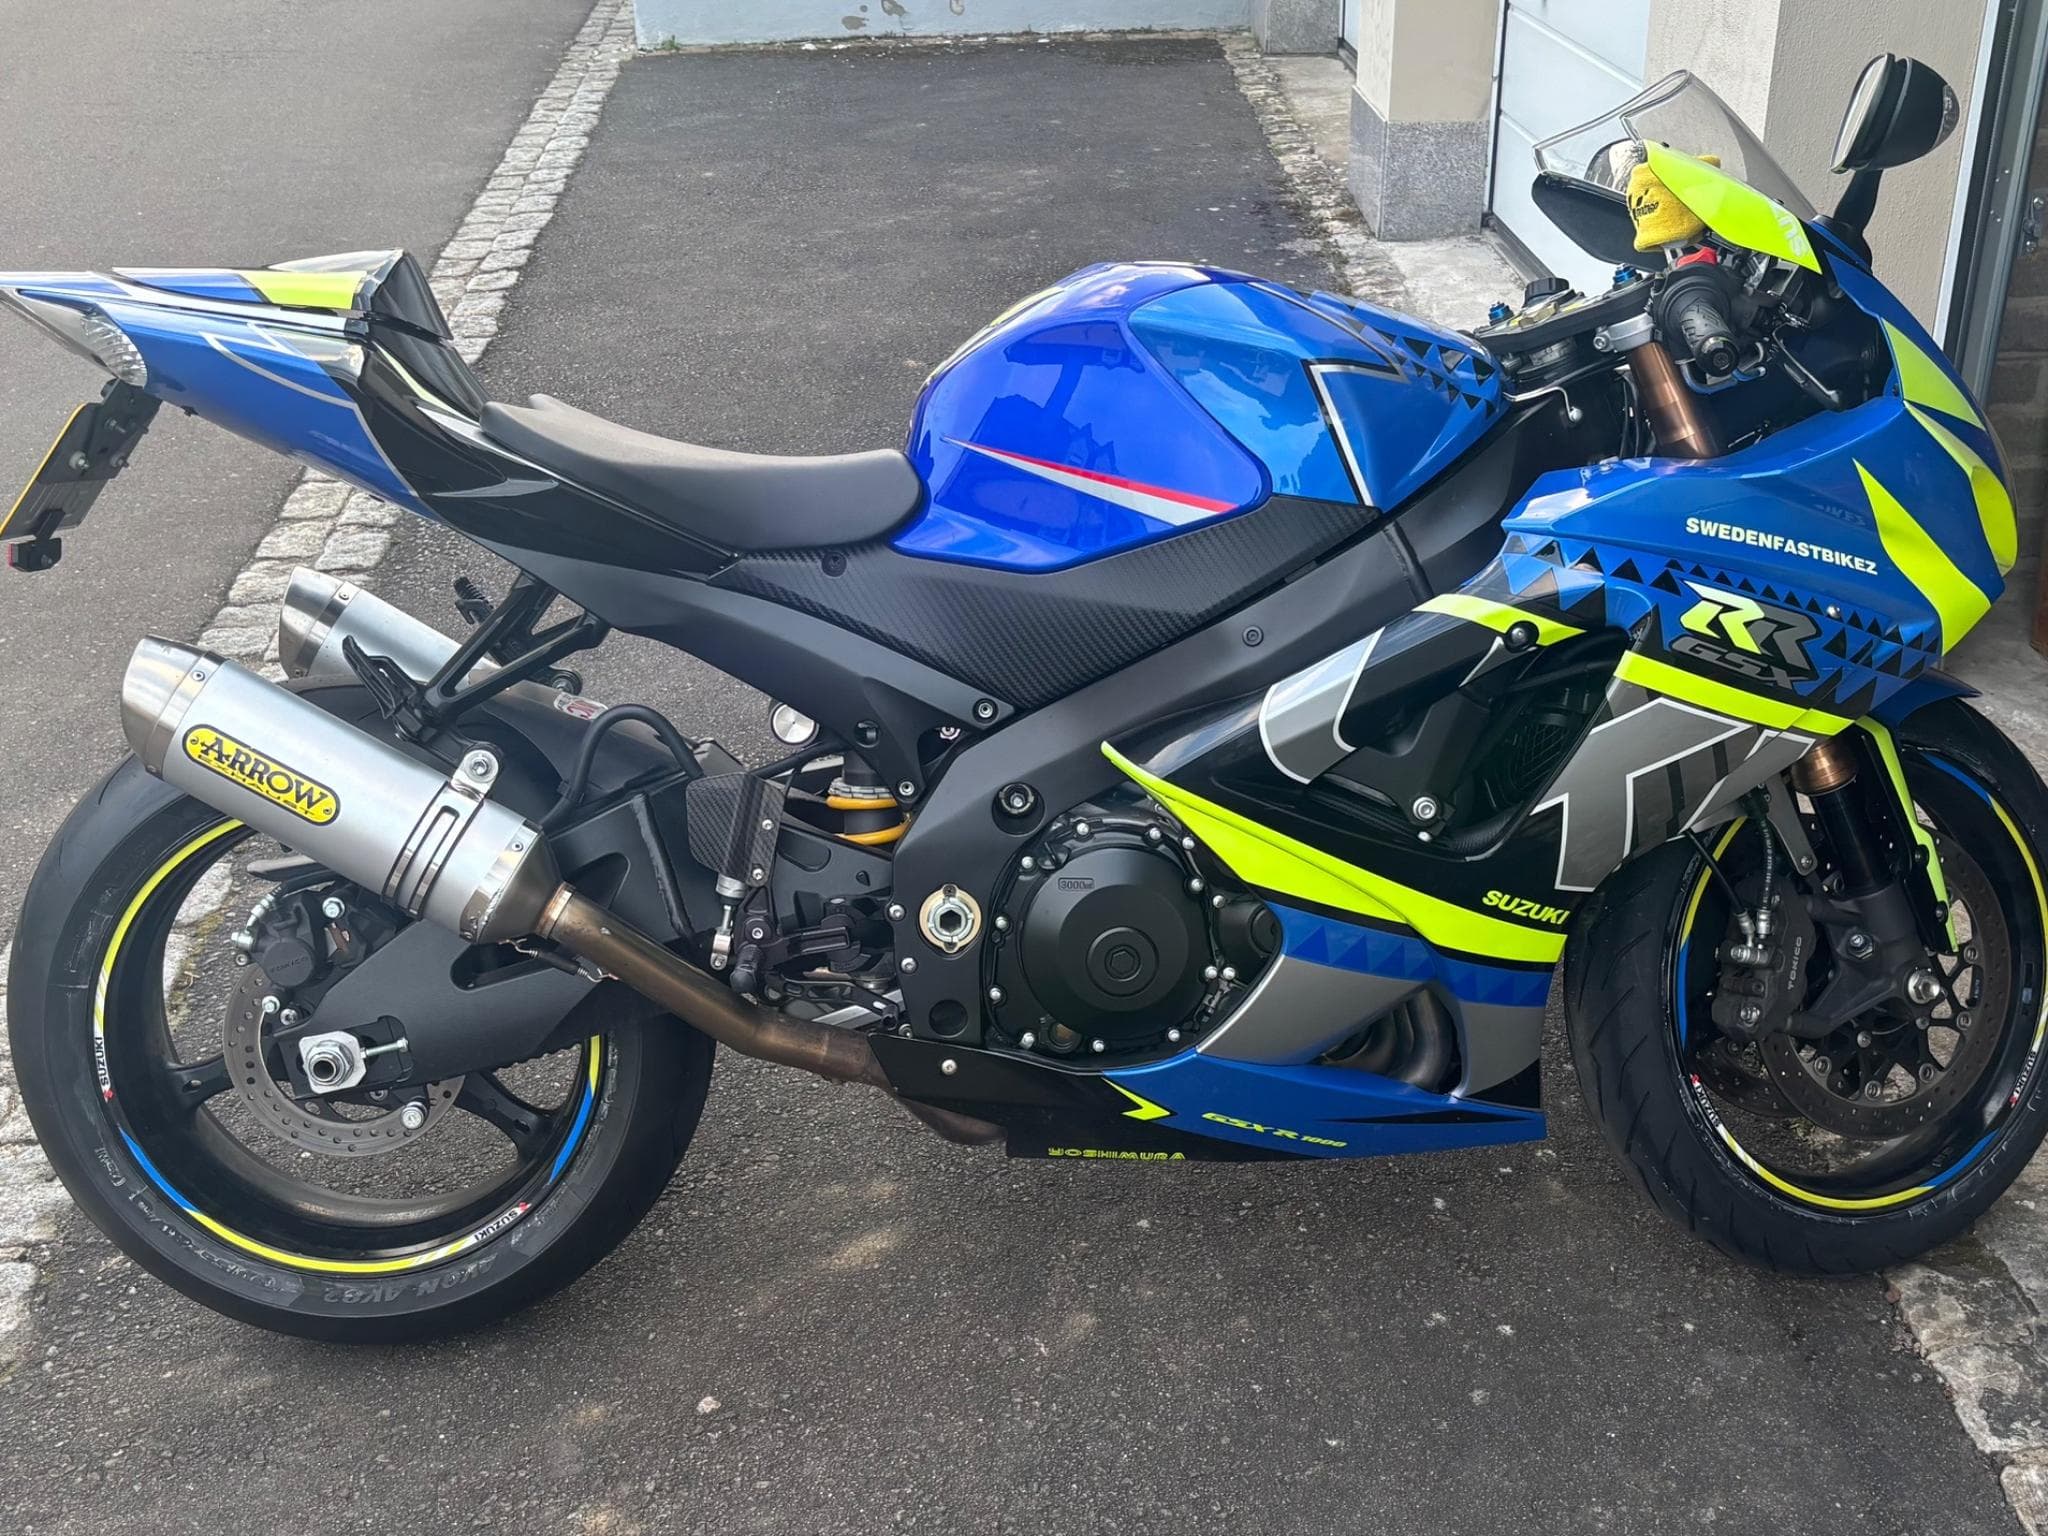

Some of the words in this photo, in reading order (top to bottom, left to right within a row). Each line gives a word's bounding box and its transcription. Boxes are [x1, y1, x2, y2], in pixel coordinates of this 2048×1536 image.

[1686, 517, 1878, 576] SWEDENFASTBIKEZ
[1671, 636, 1809, 691] GSX
[199, 736, 329, 810] ARROW
[1482, 890, 1570, 925] SUZUKI
[1787, 936, 1802, 990] TOKICO
[94, 1036, 110, 1087] SUZUKI
[1047, 1147, 1186, 1160] YOSHIMURA
[1300, 1135, 1349, 1148] 1000
[474, 1210, 518, 1241] SUZUKI
